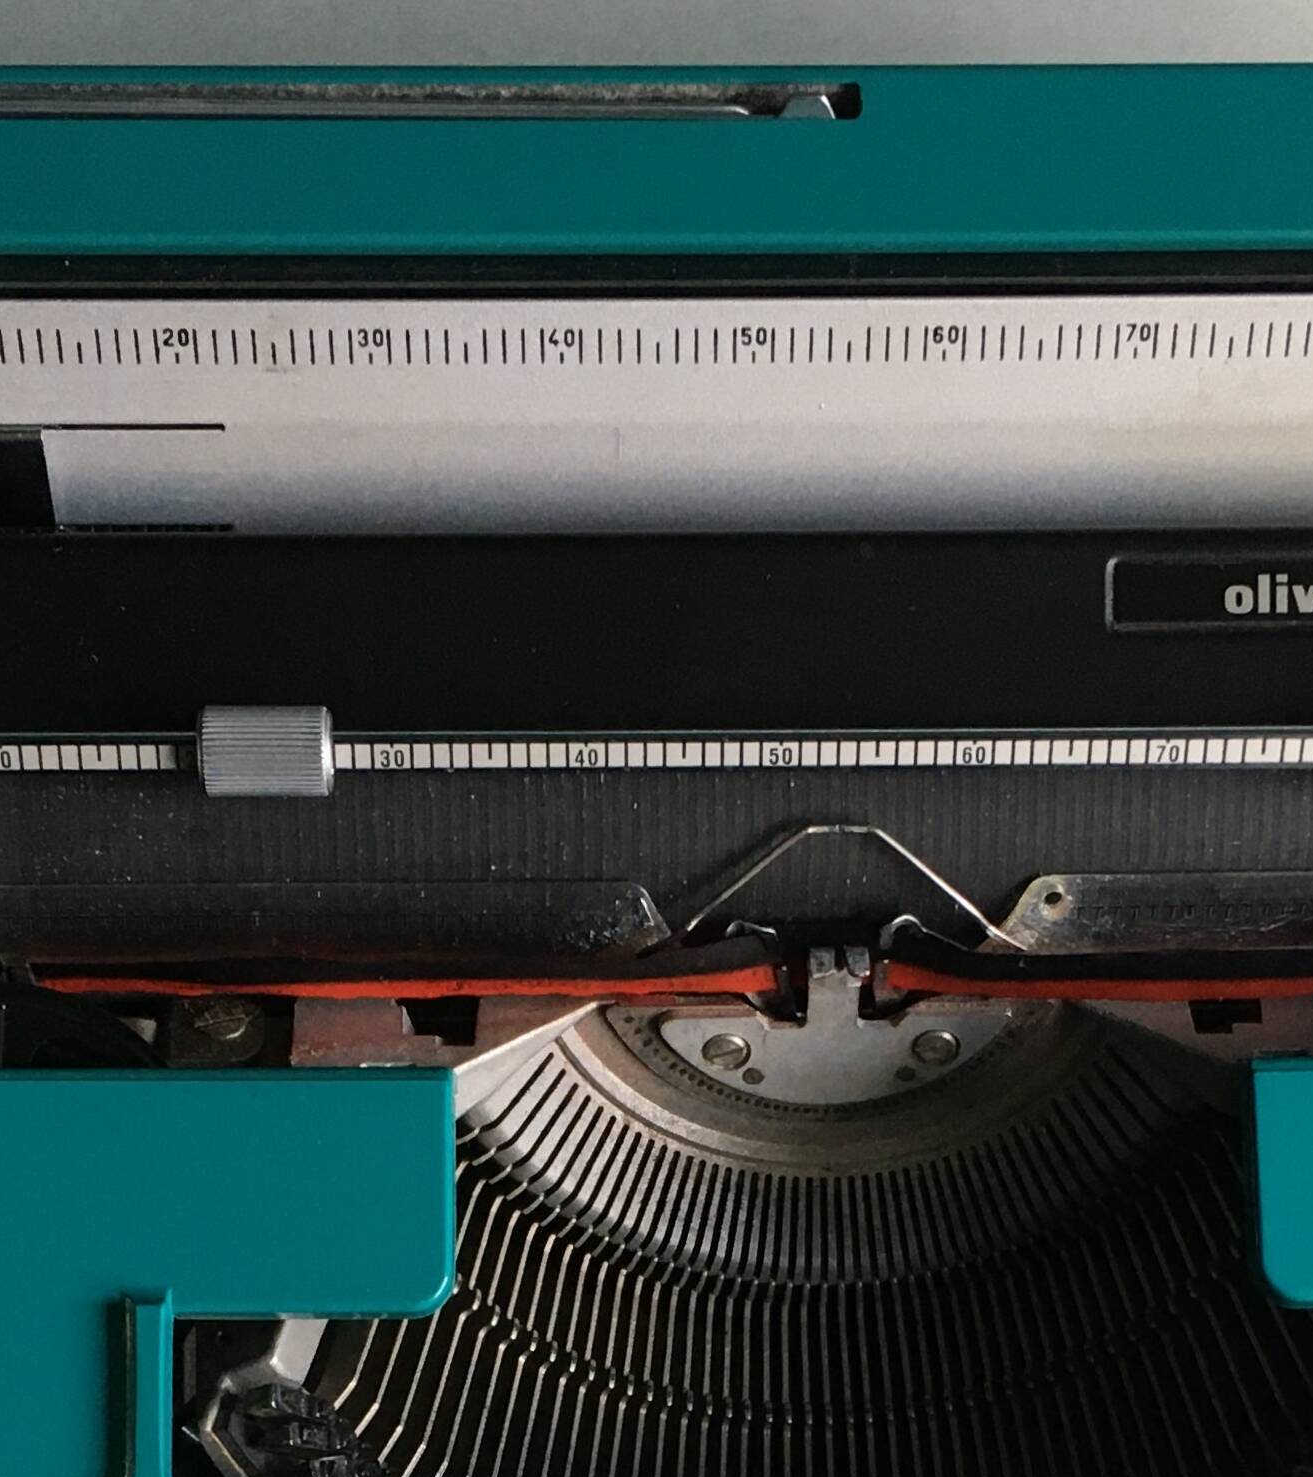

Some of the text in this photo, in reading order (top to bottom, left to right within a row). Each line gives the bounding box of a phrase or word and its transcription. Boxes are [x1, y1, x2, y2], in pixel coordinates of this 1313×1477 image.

[162, 328, 189, 347] 20
[357, 329, 384, 348] 30
[548, 329, 575, 347] 40
[741, 328, 767, 345] 50
[932, 325, 959, 344] 60
[1126, 323, 1151, 343] 70
[381, 749, 405, 767] 30
[575, 749, 598, 766] 40
[769, 748, 793, 765] 50
[962, 745, 987, 764] 60
[1156, 745, 1180, 762] 70
